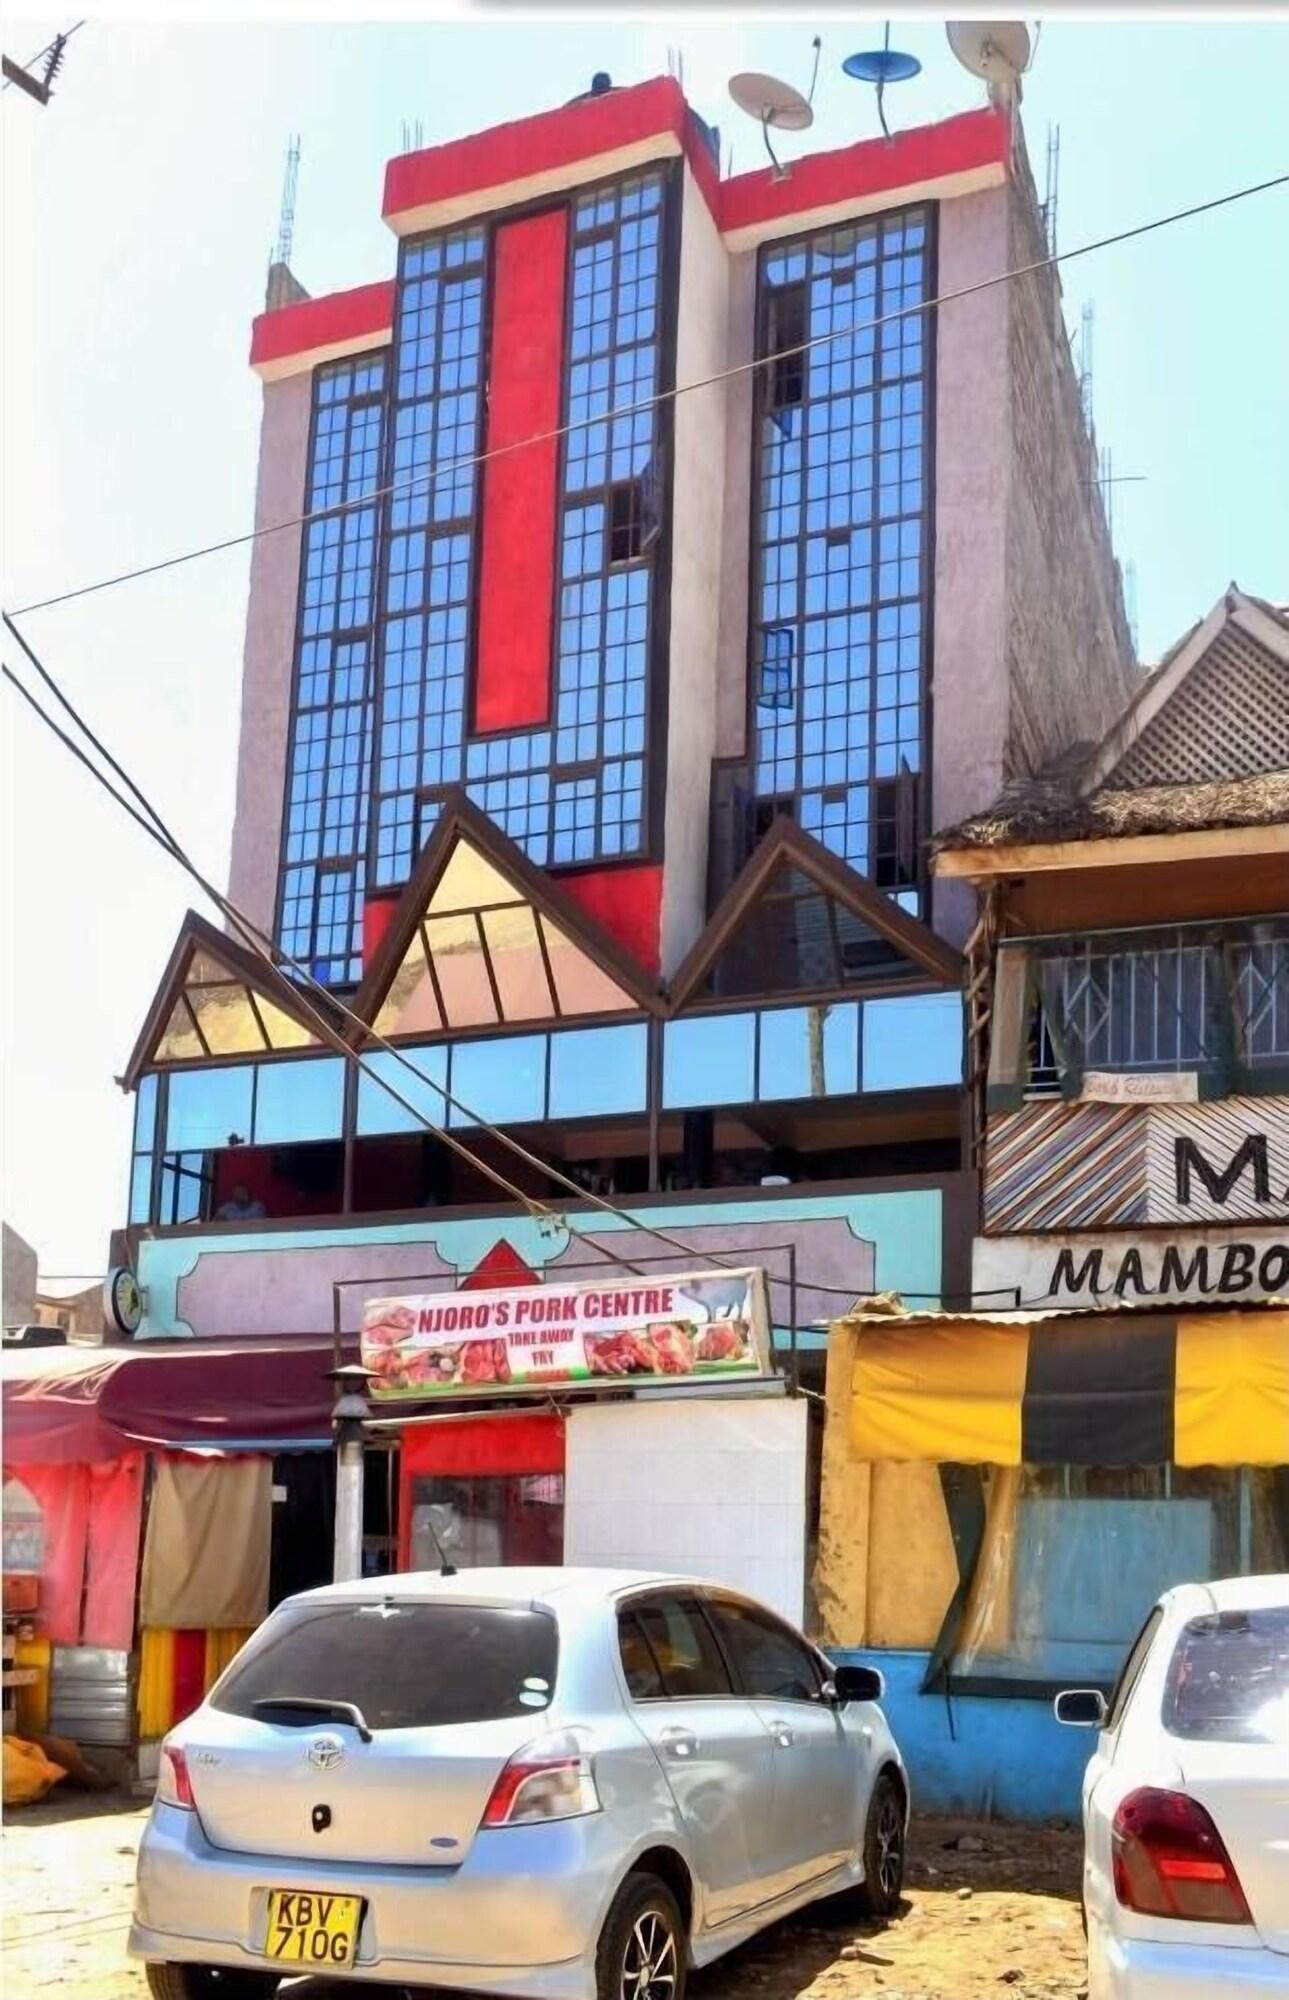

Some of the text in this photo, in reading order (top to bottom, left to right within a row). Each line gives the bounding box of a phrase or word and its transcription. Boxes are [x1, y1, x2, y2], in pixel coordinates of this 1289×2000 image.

[1174, 1133, 1289, 1205] M
[1050, 1244, 1289, 1298] MAMBO
[418, 1288, 674, 1333] NJORO'S PORK CENTRE
[508, 1328, 575, 1347] TAKE AWAY
[277, 1894, 333, 1927] KBV
[274, 1927, 349, 1962] 710G
